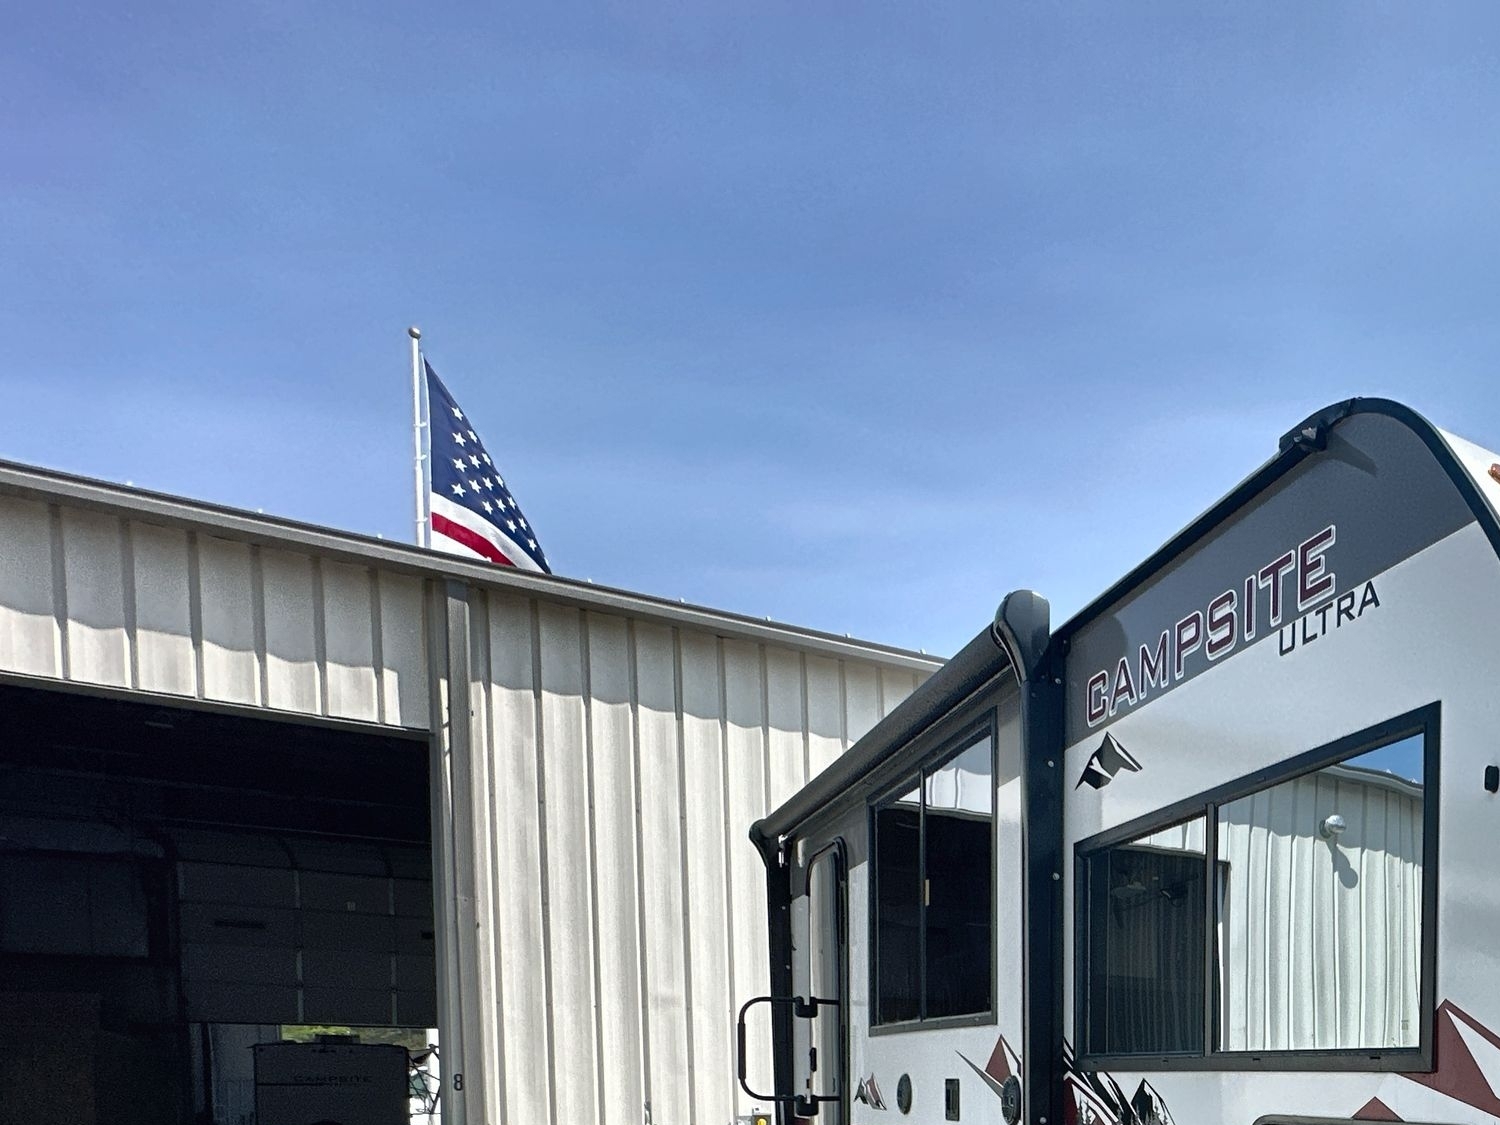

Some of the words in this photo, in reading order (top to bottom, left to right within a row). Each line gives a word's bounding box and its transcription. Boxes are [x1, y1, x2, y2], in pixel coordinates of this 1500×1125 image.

[1086, 524, 1336, 728] CAMPSITE
[1279, 580, 1380, 656] ULTRA
[454, 1073, 463, 1091] 8
